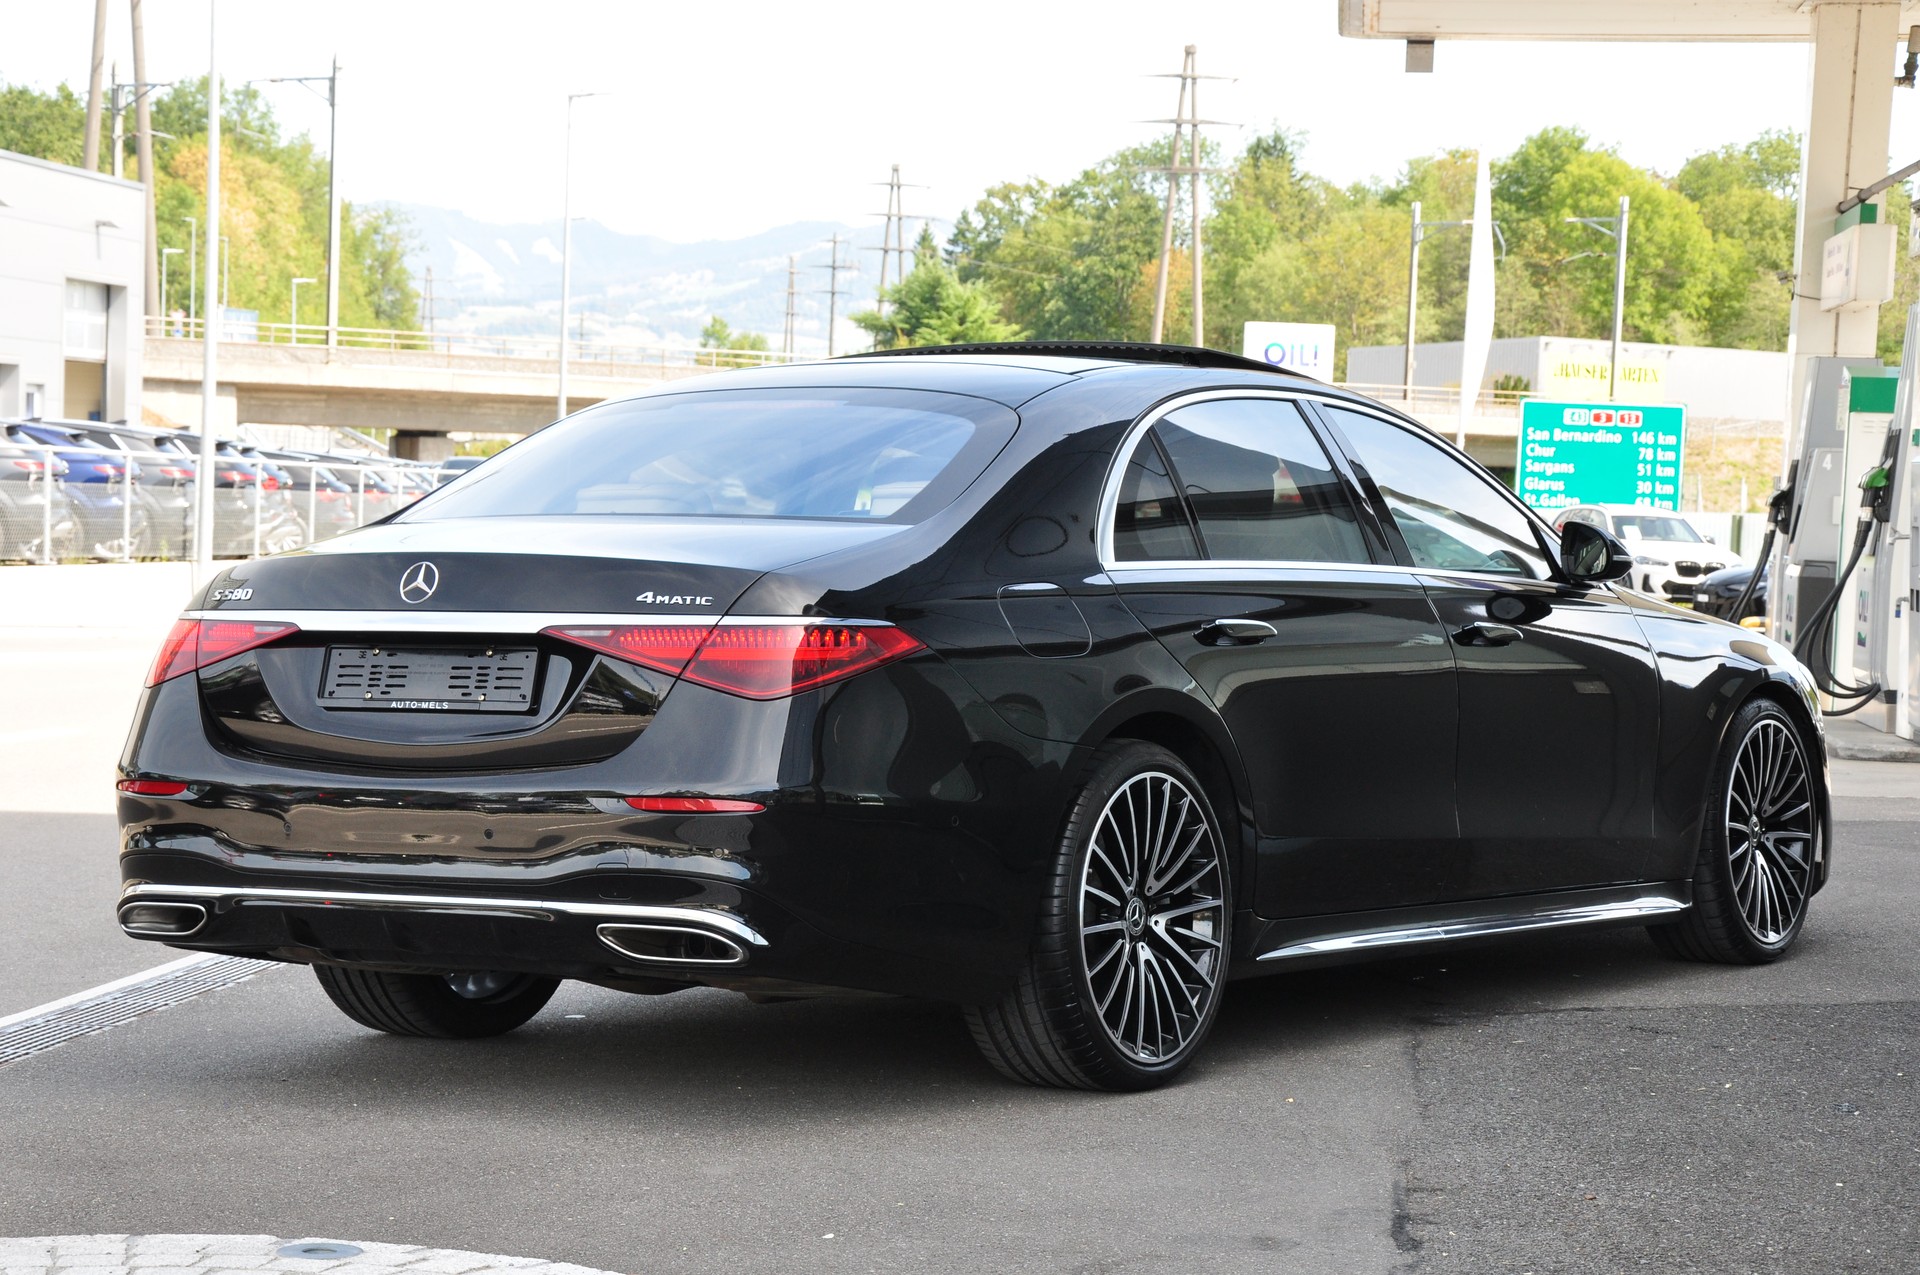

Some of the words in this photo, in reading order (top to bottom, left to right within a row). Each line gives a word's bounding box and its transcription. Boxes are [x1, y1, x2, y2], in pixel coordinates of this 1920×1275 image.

[1264, 342, 1318, 367] OIL!
[1526, 427, 1550, 441] San
[1553, 428, 1622, 444] Bernardino
[1631, 431, 1655, 445] 146
[1657, 432, 1677, 445] km
[1525, 443, 1556, 457] Chur
[1638, 447, 1654, 461] 78
[1657, 448, 1676, 461] km
[1525, 459, 1575, 476] Sargans
[1637, 463, 1652, 476] 51
[1656, 463, 1675, 477] km
[1822, 453, 1832, 471] 4
[1524, 476, 1565, 491] Glarus
[1636, 480, 1652, 494] 30
[1655, 481, 1674, 495] km
[1654, 497, 1673, 511] km
[636, 591, 714, 606] 4MATIC
[390, 701, 449, 709] AUTO-MELS
